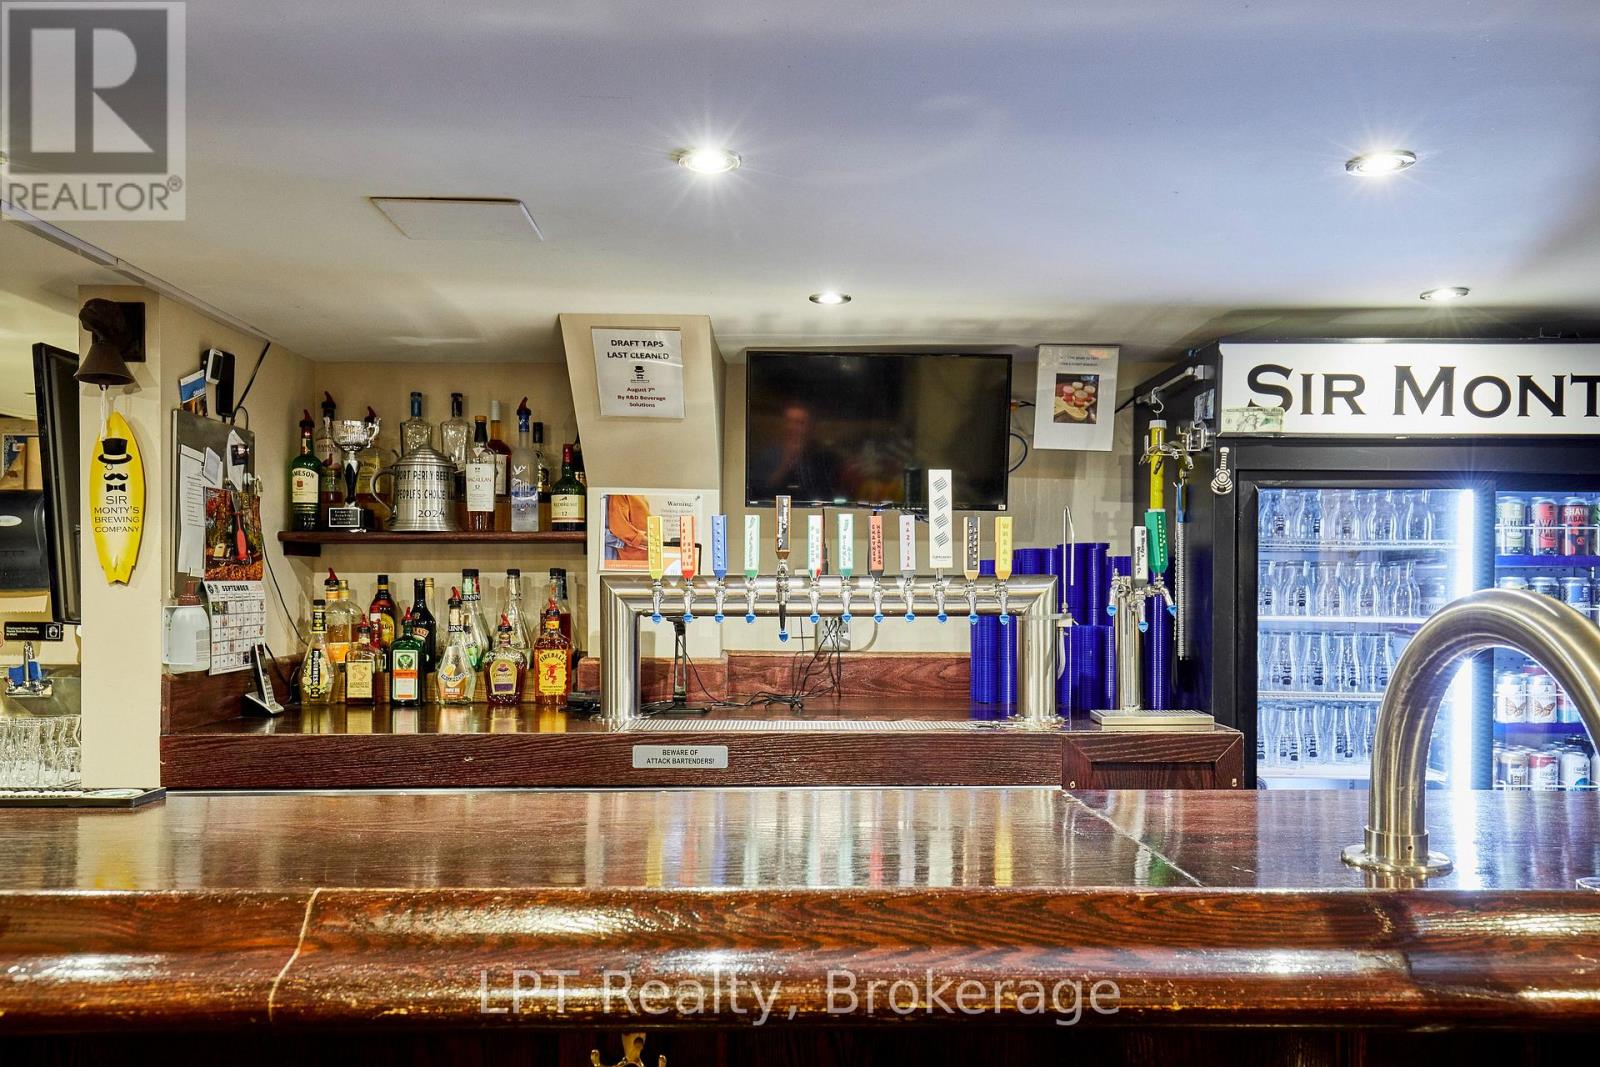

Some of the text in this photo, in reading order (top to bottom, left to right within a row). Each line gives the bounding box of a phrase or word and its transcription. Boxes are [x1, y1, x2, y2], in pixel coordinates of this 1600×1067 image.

[610, 339, 664, 348] DRAFT TAPS
[630, 352, 670, 360] CLEANED
[106, 495, 127, 504] SIR
[94, 505, 140, 514] MONTY'S
[418, 508, 446, 518] 2024
